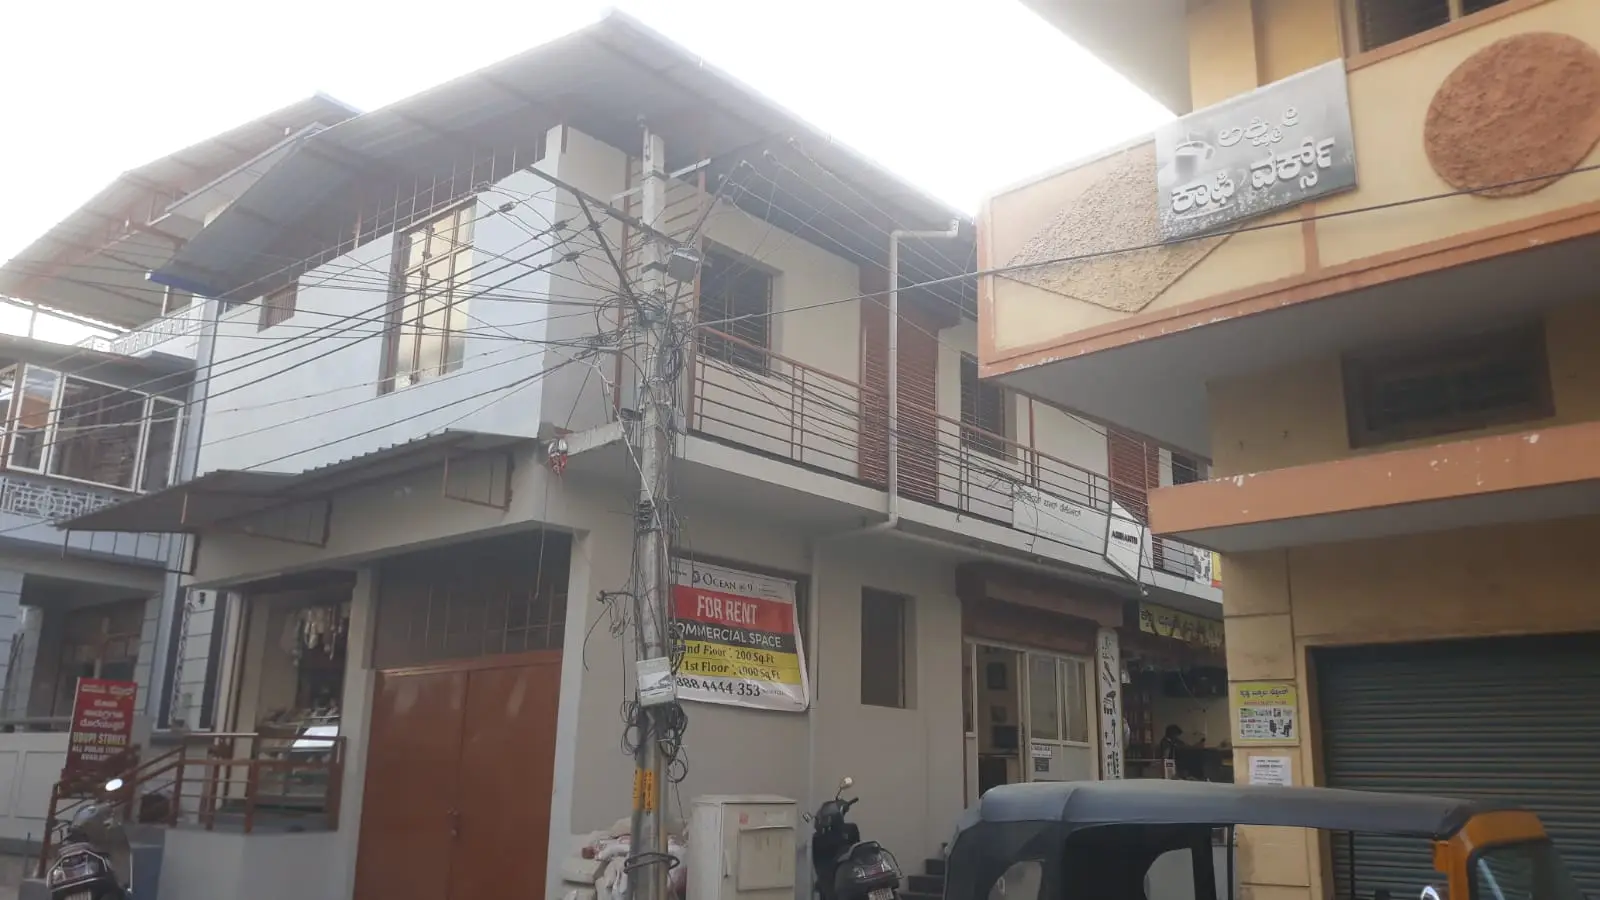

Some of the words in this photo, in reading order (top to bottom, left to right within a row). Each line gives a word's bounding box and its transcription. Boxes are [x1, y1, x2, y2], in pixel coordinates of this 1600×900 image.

[697, 595, 722, 620] FOR
[726, 600, 757, 625] RENT
[669, 622, 746, 643] OMMERCIAL
[749, 632, 782, 648] SPACE
[703, 644, 727, 656] Floor
[735, 649, 752, 661] 200
[684, 660, 699, 671] 1st
[702, 661, 730, 673] Floor
[702, 680, 733, 695] 4444
[736, 682, 760, 697] 353
